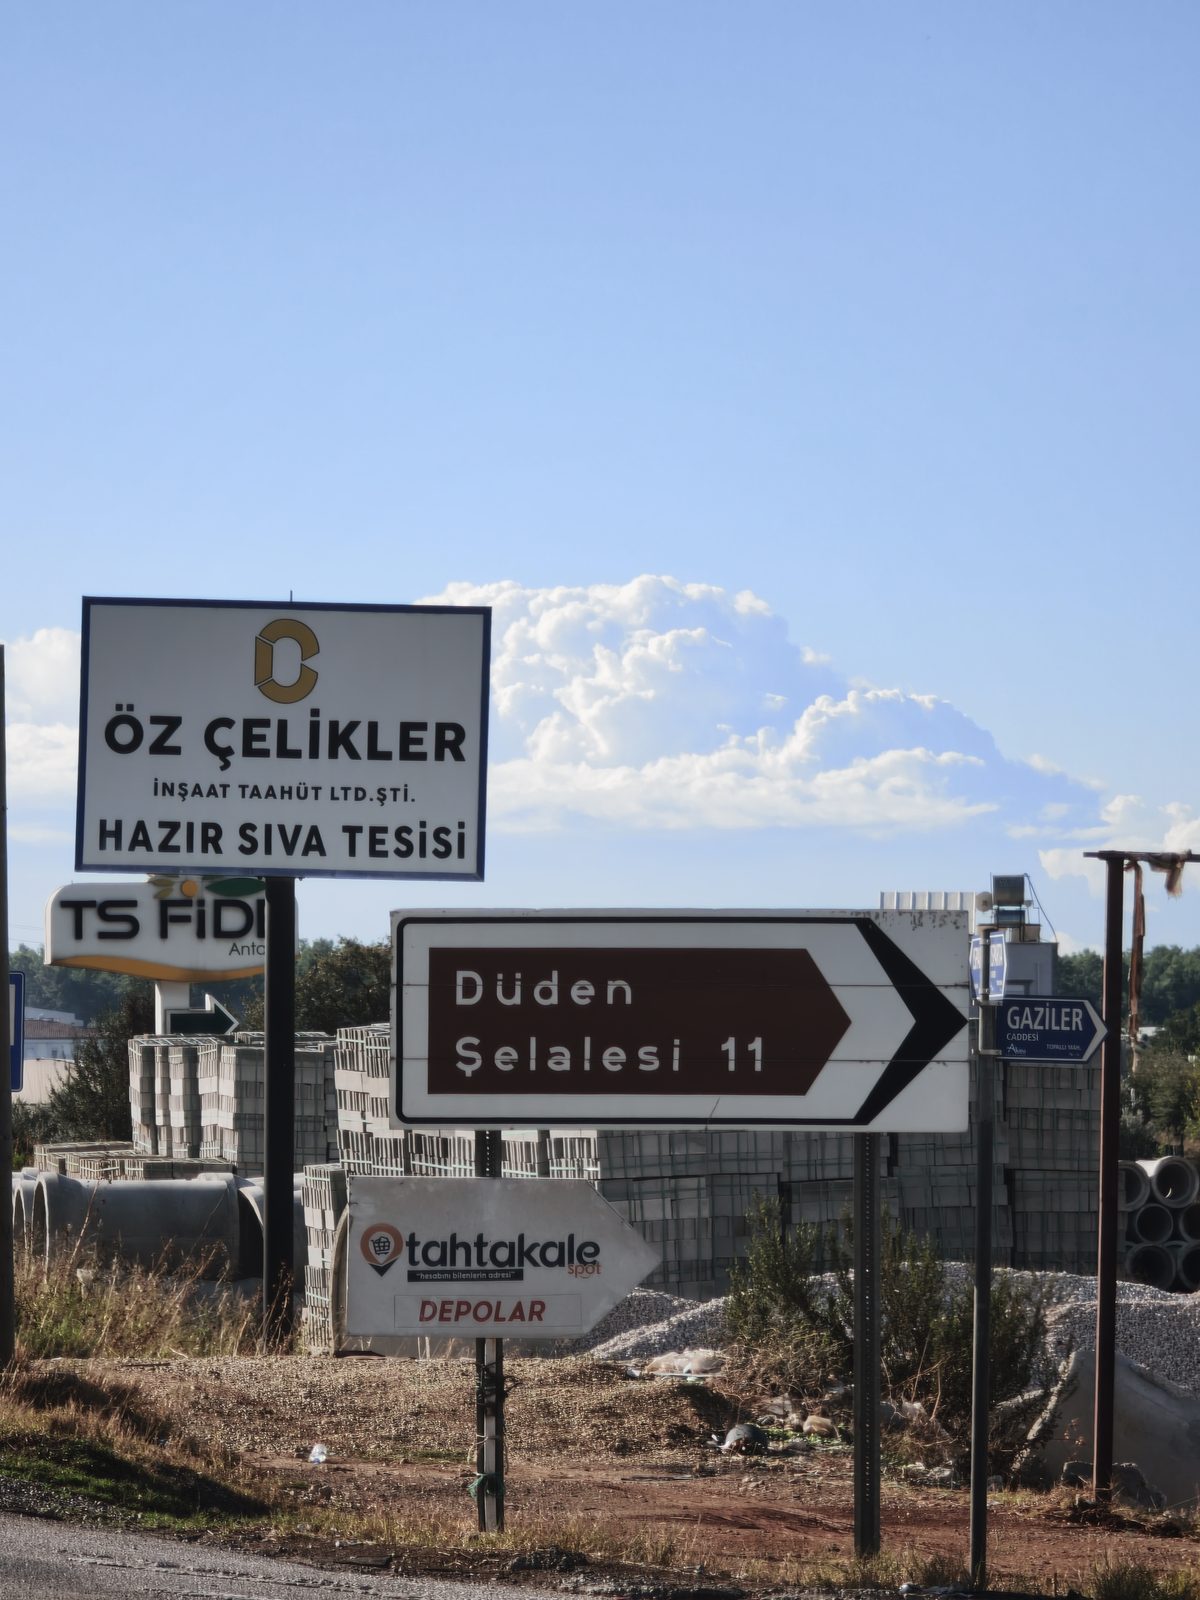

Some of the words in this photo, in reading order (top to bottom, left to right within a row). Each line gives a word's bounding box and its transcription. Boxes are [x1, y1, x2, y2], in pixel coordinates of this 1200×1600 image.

[104, 702, 183, 756] ÖZ
[203, 707, 467, 772] ÇELİKLER
[153, 777, 231, 803] İNŞAAT
[237, 781, 323, 802] TAAHÜT
[98, 818, 224, 855] HAZIR
[237, 822, 327, 857] SIVA
[59, 899, 141, 941] TS
[455, 970, 632, 1006] Düden
[1006, 1003, 1083, 1032] GAZİLER
[1006, 1032, 1039, 1041] CADDESİ
[455, 1036, 680, 1077] Şelalesi
[721, 1036, 762, 1072] 11
[405, 1231, 601, 1269] tahtakale
[567, 1264, 602, 1279] spot
[418, 1298, 547, 1324] DEPOLAR
